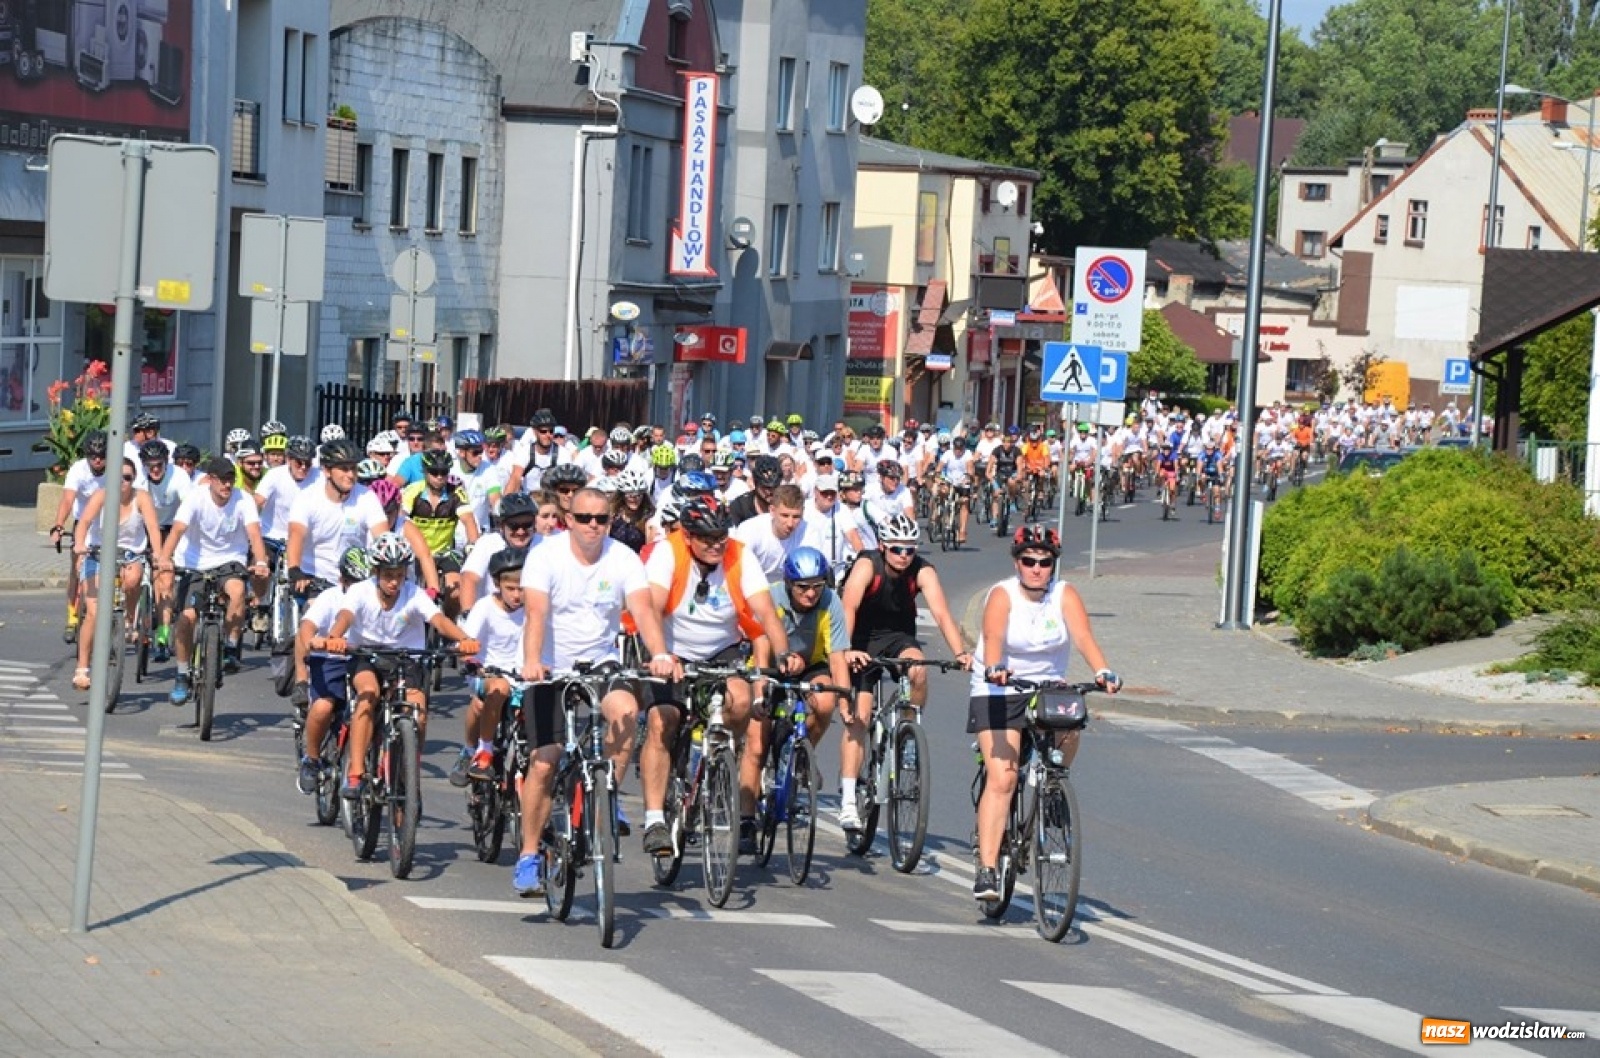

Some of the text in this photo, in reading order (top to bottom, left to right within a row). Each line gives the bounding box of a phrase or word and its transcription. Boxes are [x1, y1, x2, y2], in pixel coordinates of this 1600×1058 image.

[683, 80, 707, 270] PASAŻ HANDLOWY
[1092, 281, 1101, 293] 2
[1450, 362, 1465, 381] P
